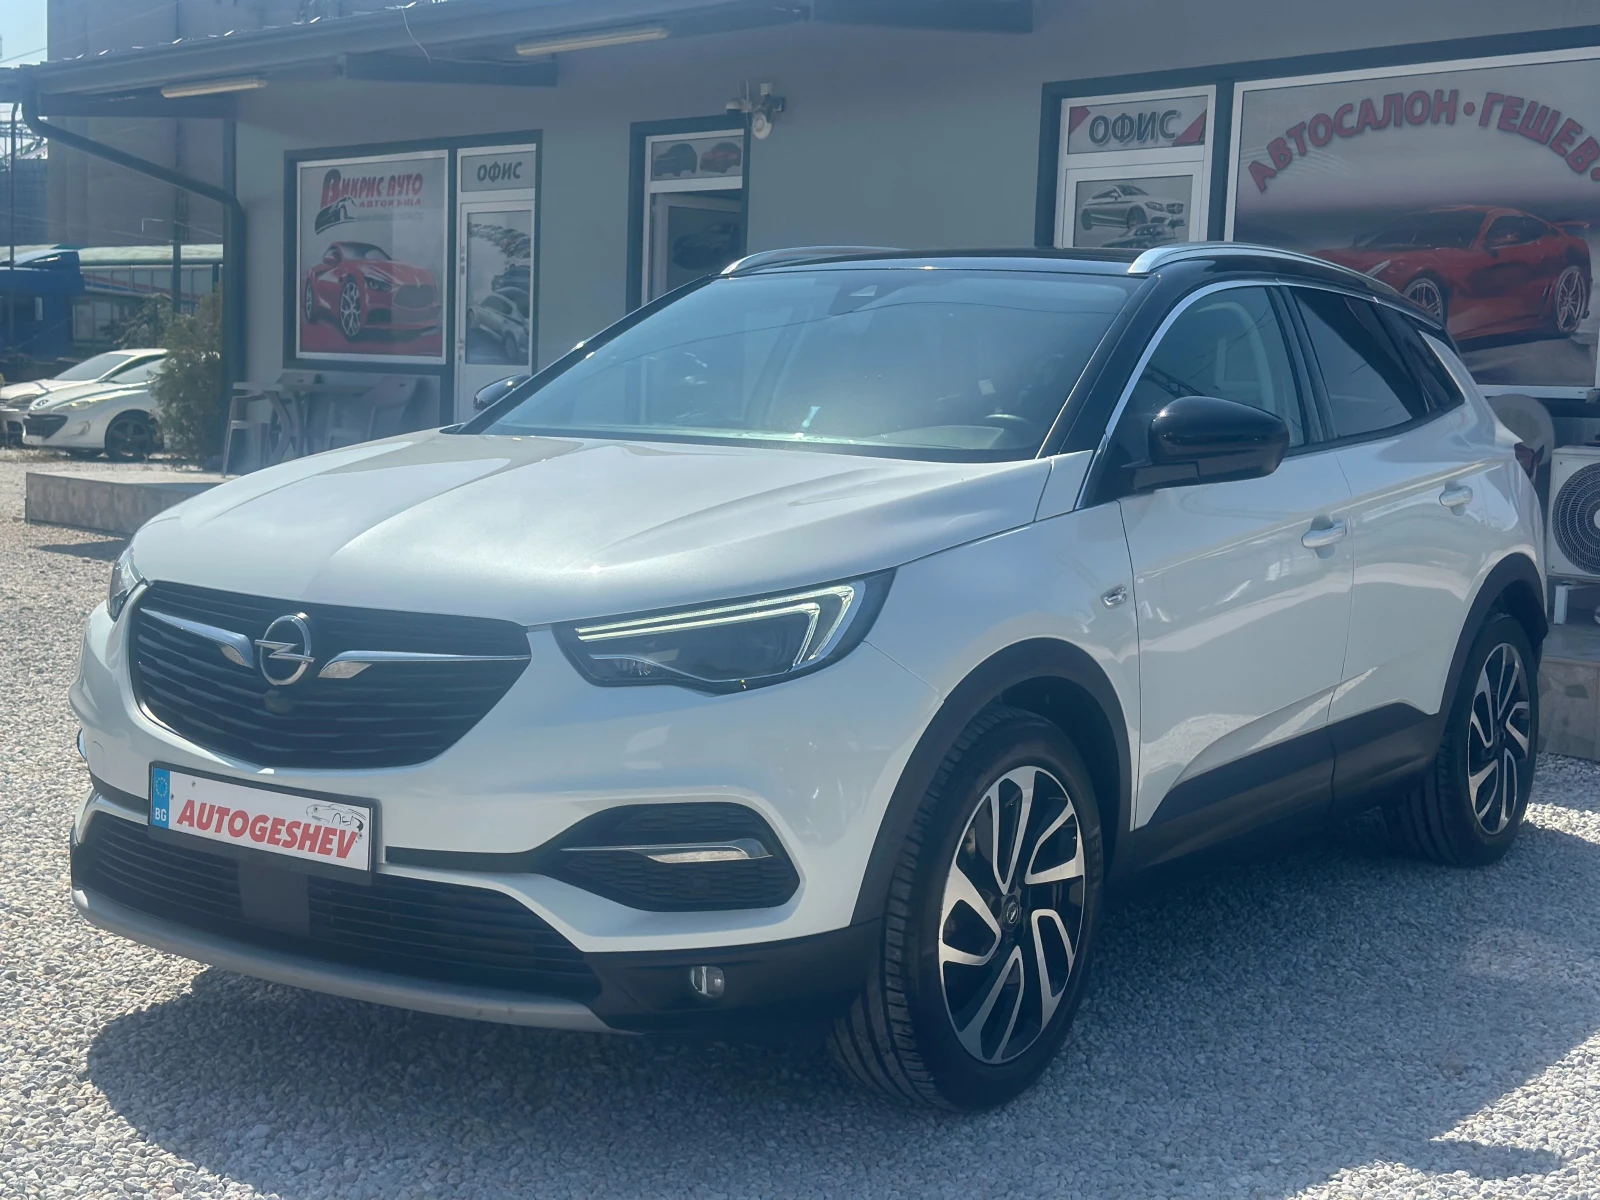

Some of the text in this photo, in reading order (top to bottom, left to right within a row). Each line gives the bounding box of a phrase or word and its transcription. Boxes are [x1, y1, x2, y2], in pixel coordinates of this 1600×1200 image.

[1088, 109, 1180, 144] ОФИС
[1248, 89, 1600, 194] АВТОСАЛОН ГЕШЕВ
[387, 172, 424, 198] АУТО
[476, 161, 523, 183] ОФИС
[155, 807, 167, 822] BG
[176, 799, 358, 859] AUTOGESHEV
